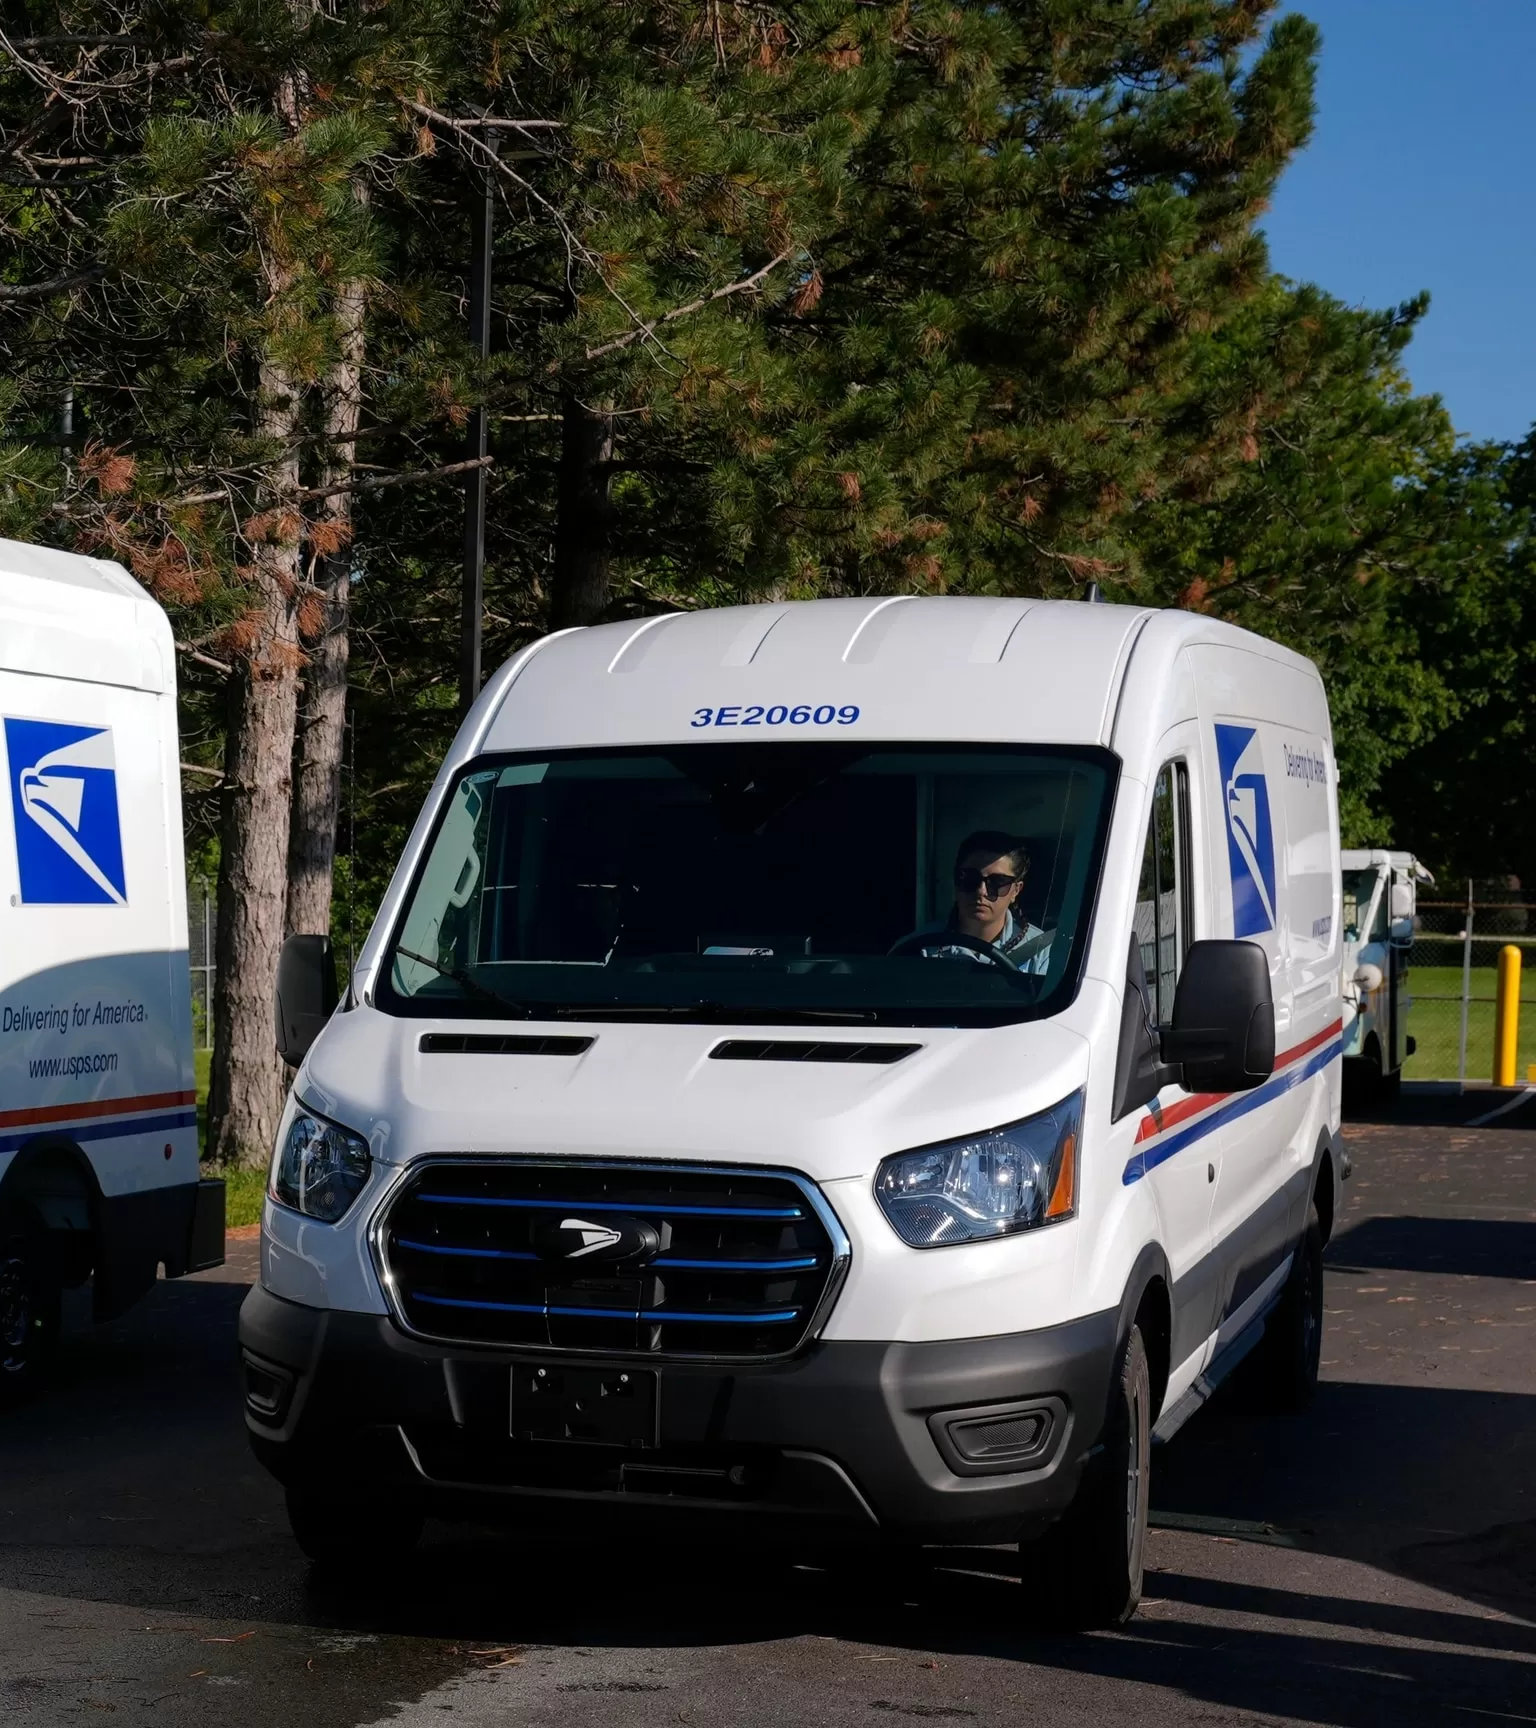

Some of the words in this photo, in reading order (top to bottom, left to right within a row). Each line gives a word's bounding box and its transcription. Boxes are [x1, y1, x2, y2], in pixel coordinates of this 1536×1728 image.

[690, 705, 860, 728] 3E20609
[2, 1004, 69, 1035] Delivering
[71, 1002, 91, 1027] for
[29, 1052, 118, 1080] www.usps.com
